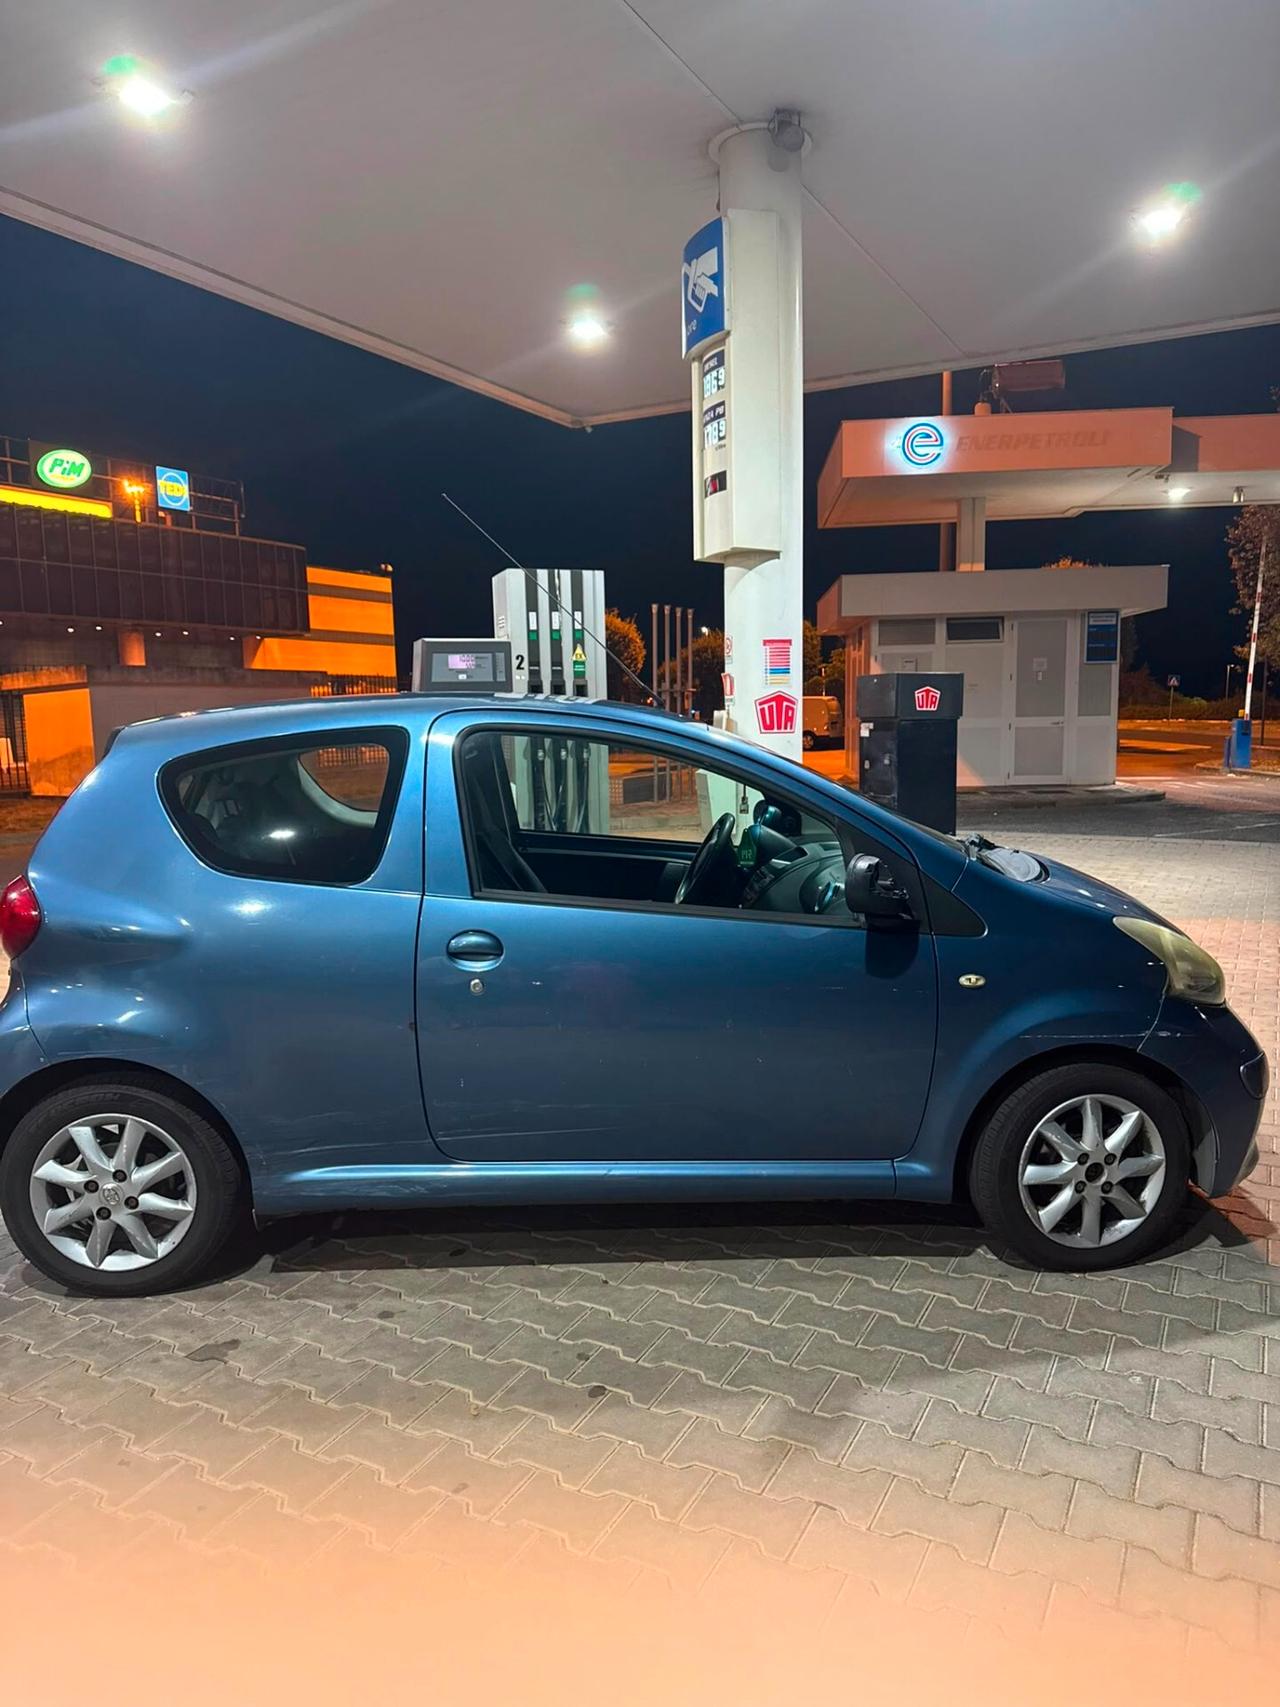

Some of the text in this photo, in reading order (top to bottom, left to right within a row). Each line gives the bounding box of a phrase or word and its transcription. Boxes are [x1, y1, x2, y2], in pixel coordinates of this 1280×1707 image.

[956, 429, 1110, 451] ENERPETROLI
[515, 654, 525, 670] 2
[915, 687, 940, 709] UTA
[757, 693, 797, 731] UTA
